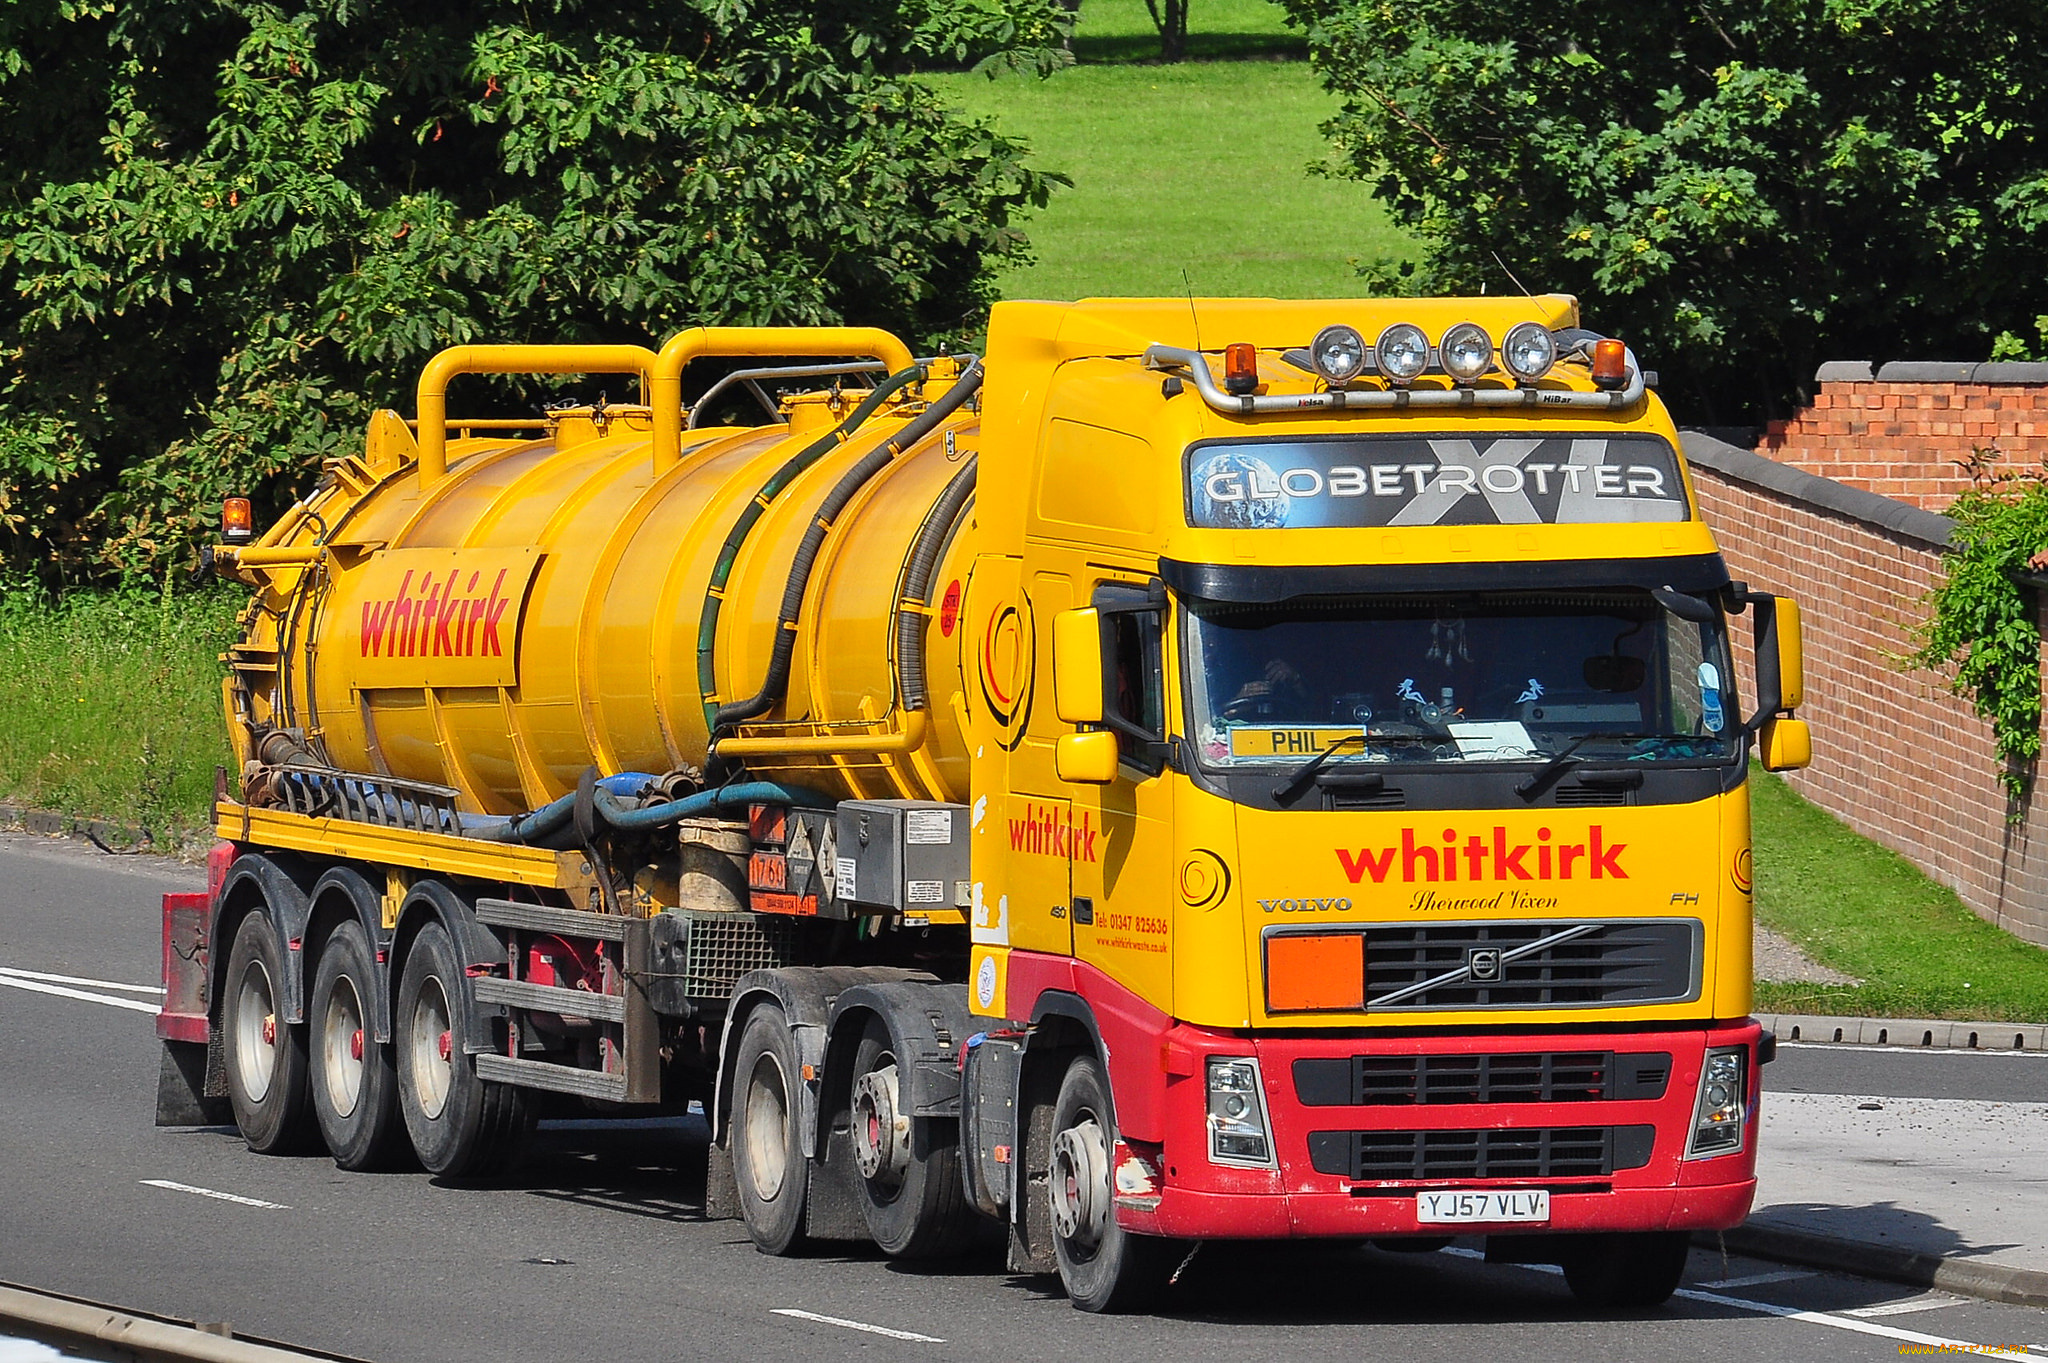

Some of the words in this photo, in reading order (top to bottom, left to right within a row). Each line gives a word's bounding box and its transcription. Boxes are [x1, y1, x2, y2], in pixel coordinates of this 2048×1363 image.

[1543, 394, 1572, 404] HiBar
[1204, 462, 1668, 502] GLOBETROTTER
[361, 568, 510, 658] whitkirk
[1271, 731, 1325, 753] PHIL
[1008, 803, 1097, 862] whitkirk
[1335, 825, 1630, 884] whitkirk
[1257, 897, 1353, 913] VOLVO
[1409, 889, 1504, 911] Sherwood
[1507, 889, 1560, 909] Vixen
[1669, 892, 1699, 905] FH
[1095, 912, 1108, 928] Tel:
[1110, 913, 1132, 931] 01347
[1136, 916, 1168, 935] 825636
[1096, 936, 1168, 953] www.whitkirkwaste.co.uk
[1428, 1195, 1489, 1217] YJ57
[1497, 1192, 1540, 1216] VLV
